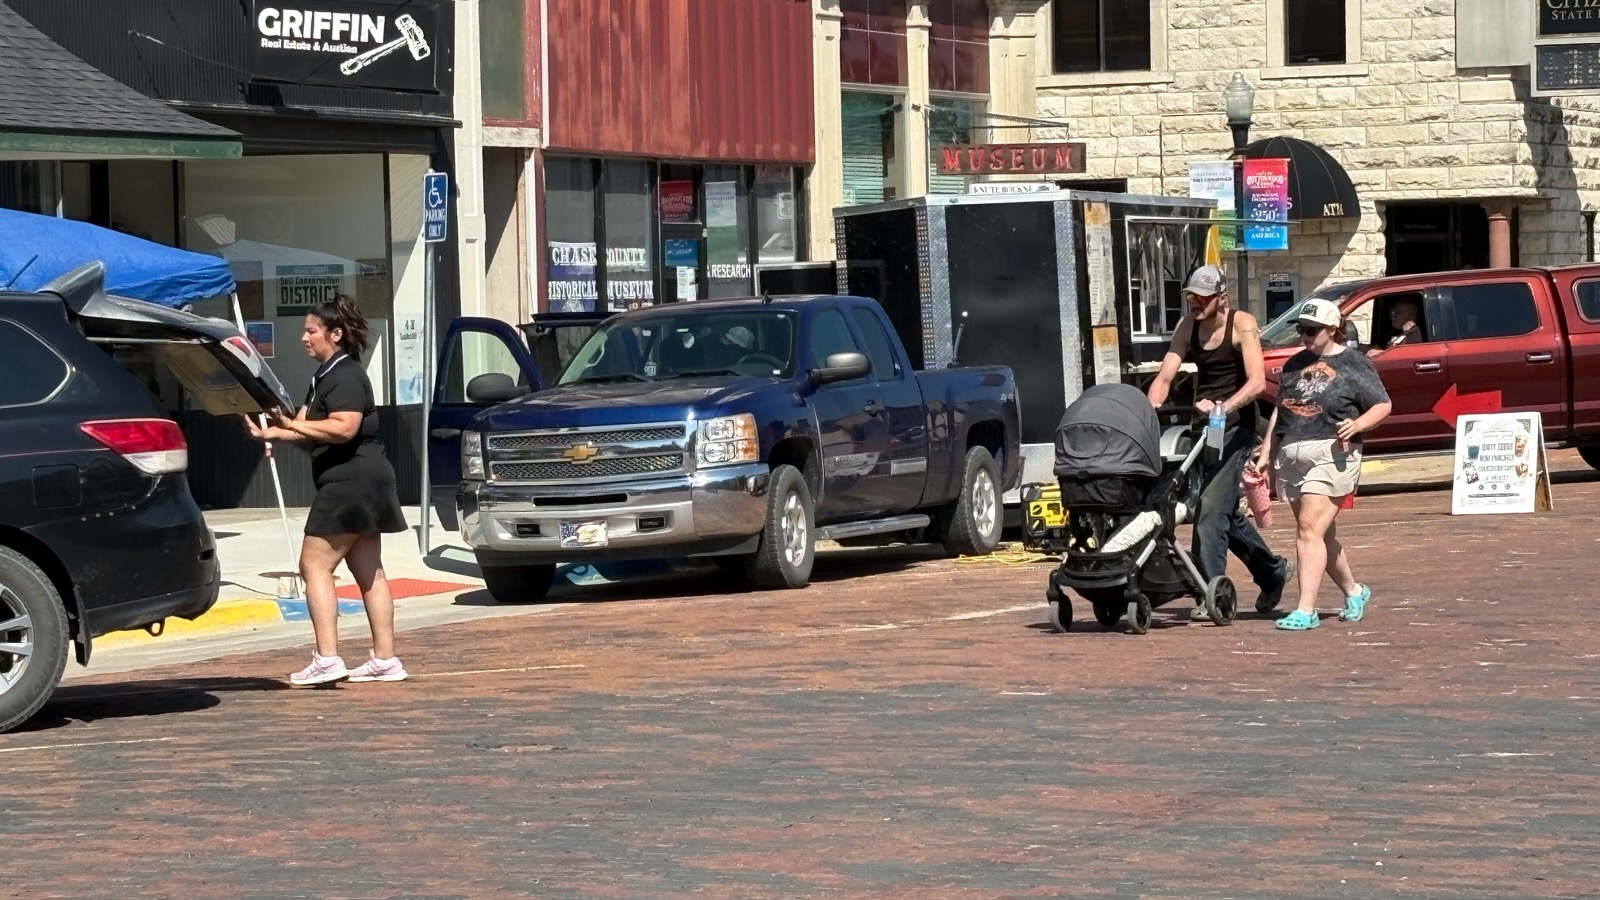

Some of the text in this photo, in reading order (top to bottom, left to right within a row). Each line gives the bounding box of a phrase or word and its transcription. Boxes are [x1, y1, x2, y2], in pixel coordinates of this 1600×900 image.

[1552, 10, 1592, 20] STATE
[258, 7, 385, 43] GRIFFIN
[261, 38, 358, 53] Real Estate & Auction
[942, 146, 1073, 172] MUSEUM
[425, 208, 446, 222] PARKING
[1255, 210, 1275, 221] 250
[1323, 202, 1344, 216] ATM
[428, 224, 442, 237] ONLY
[552, 247, 597, 266] CHASE
[711, 264, 751, 278] RESEARCH
[280, 276, 339, 285] Soil Conservation
